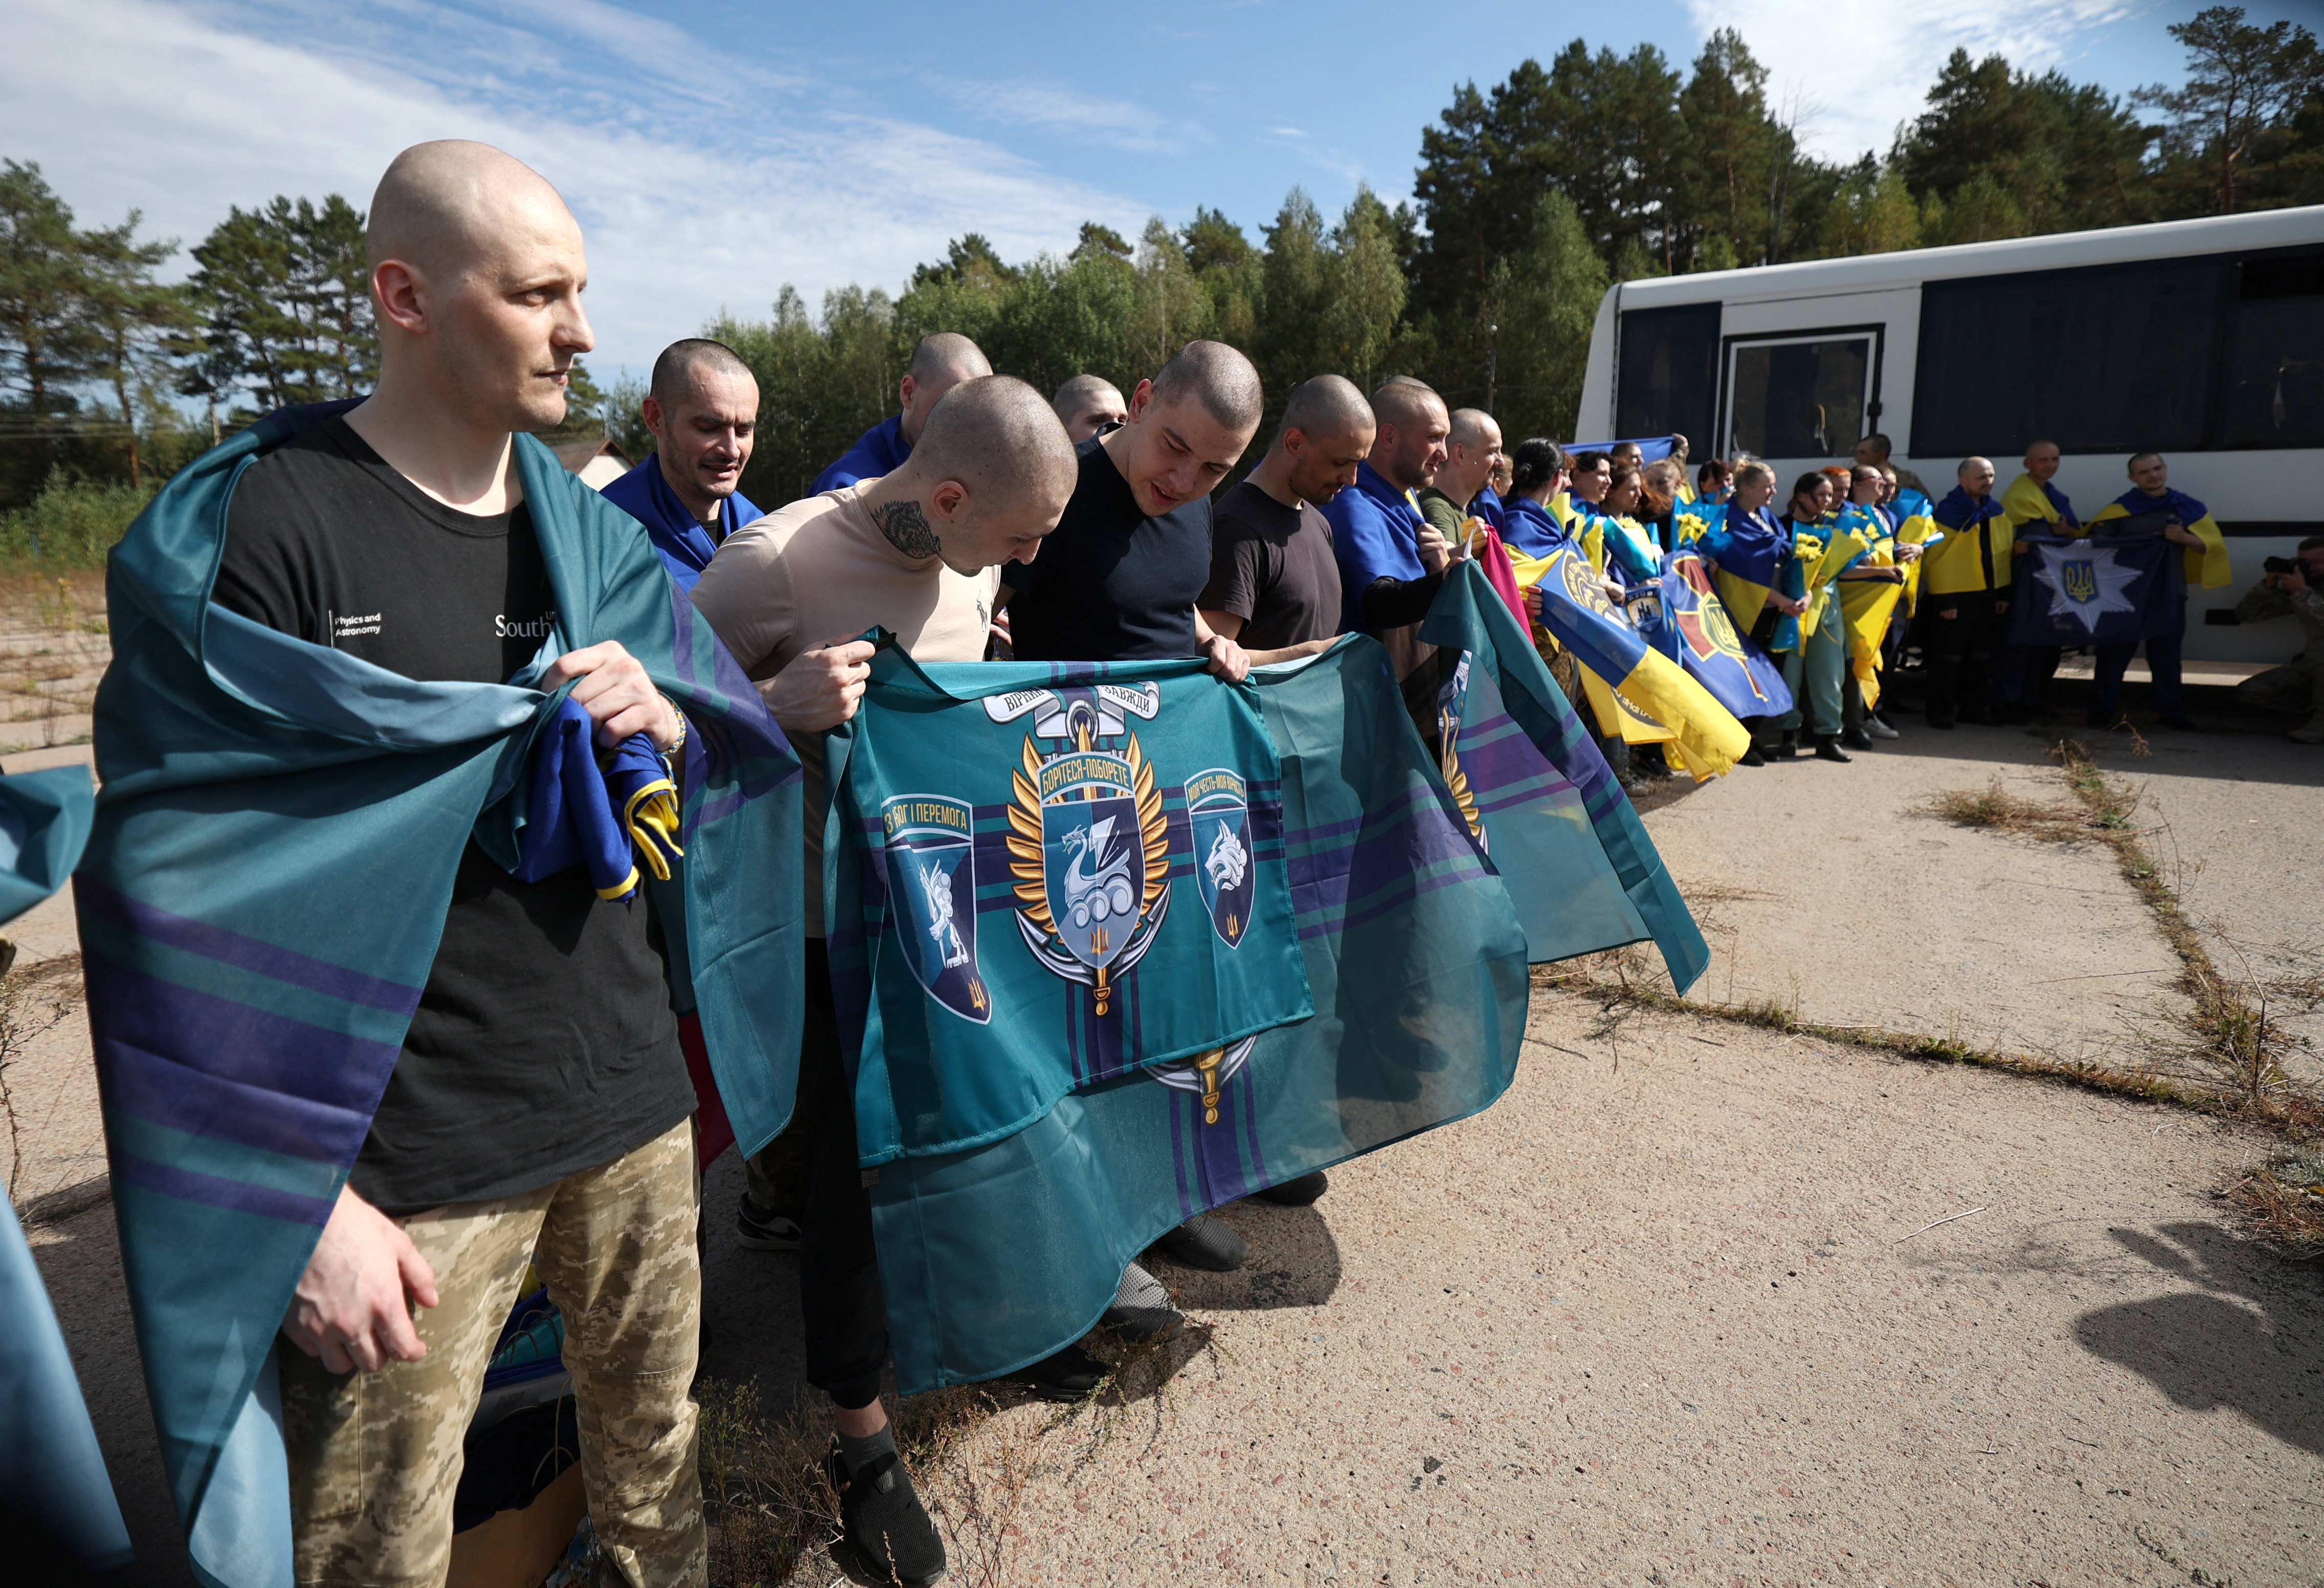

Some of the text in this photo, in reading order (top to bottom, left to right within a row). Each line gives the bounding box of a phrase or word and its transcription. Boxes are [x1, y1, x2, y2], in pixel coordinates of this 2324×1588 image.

[335, 612, 382, 627] Physics and
[335, 625, 381, 637] Astronomy
[495, 614, 552, 637] South
[1101, 686, 1150, 713] ЗАВЖДИ
[1042, 758, 1129, 796] БОРІТЕСЯ-ПОБОРЕТЕ
[1188, 782, 1200, 803] МОЯ
[884, 812, 893, 834] З
[910, 803, 914, 823] І
[916, 803, 968, 830] ПЕРЕМОГА
